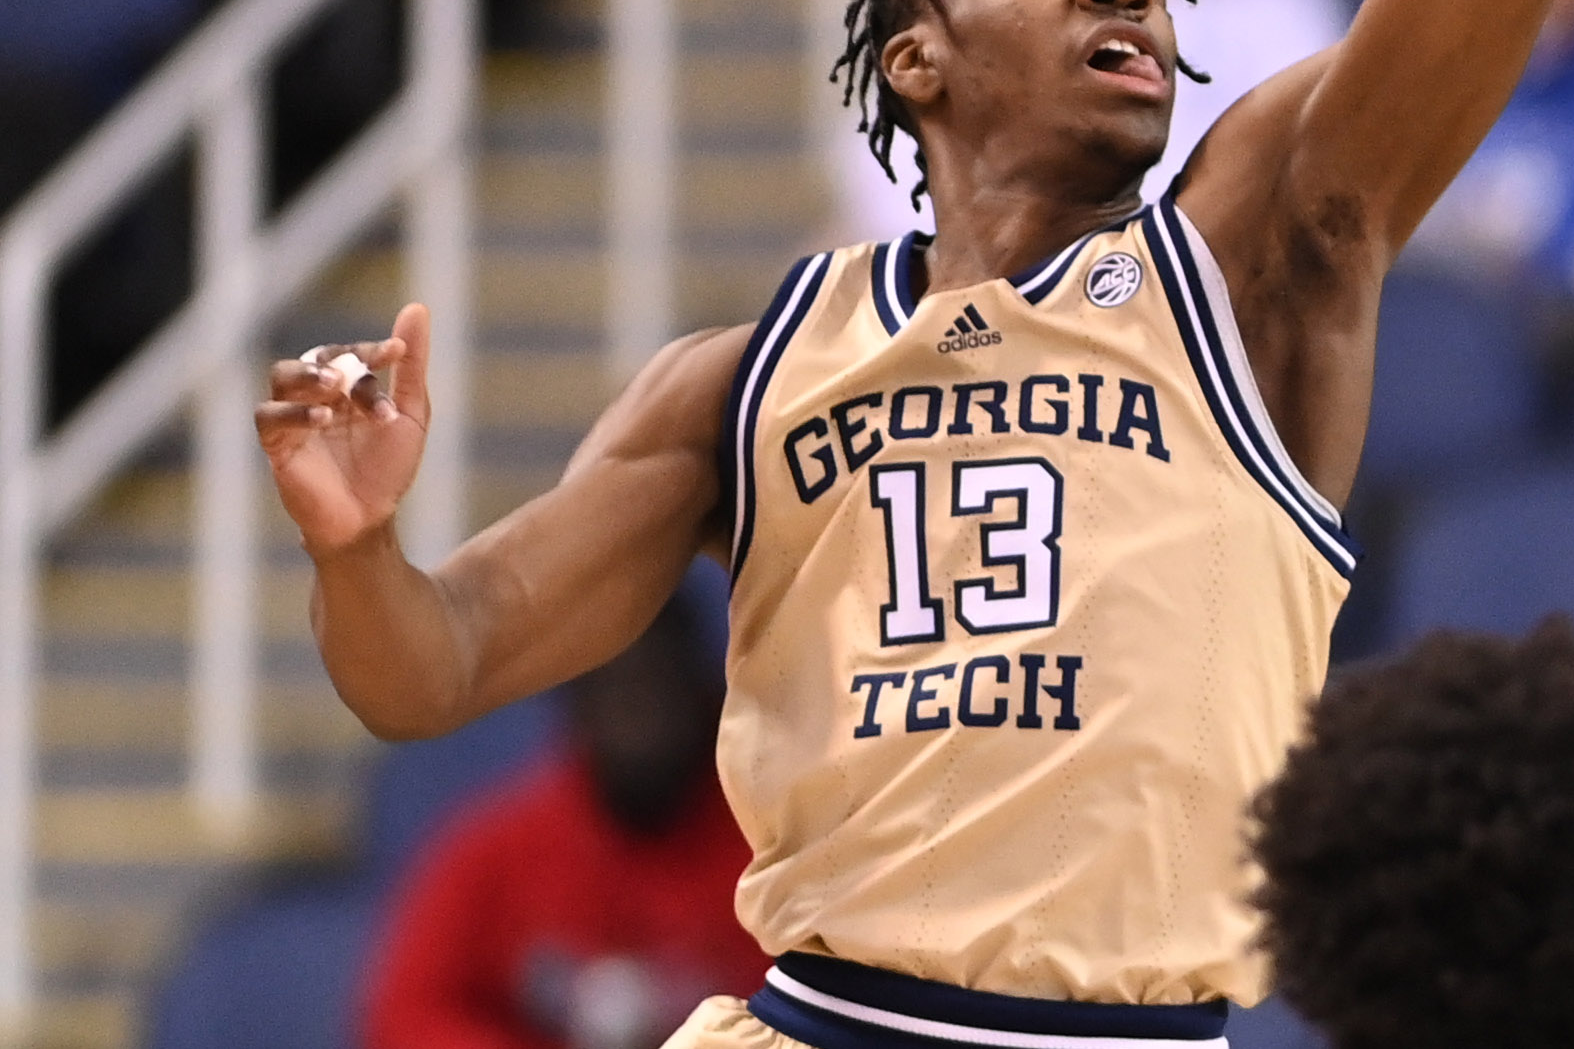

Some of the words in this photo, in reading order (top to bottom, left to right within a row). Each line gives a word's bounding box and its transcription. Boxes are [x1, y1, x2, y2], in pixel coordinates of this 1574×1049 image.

[937, 330, 1003, 354] adidas
[782, 372, 1171, 505] GEORGIA
[869, 455, 1065, 647] 13
[850, 653, 1084, 739] TECH
